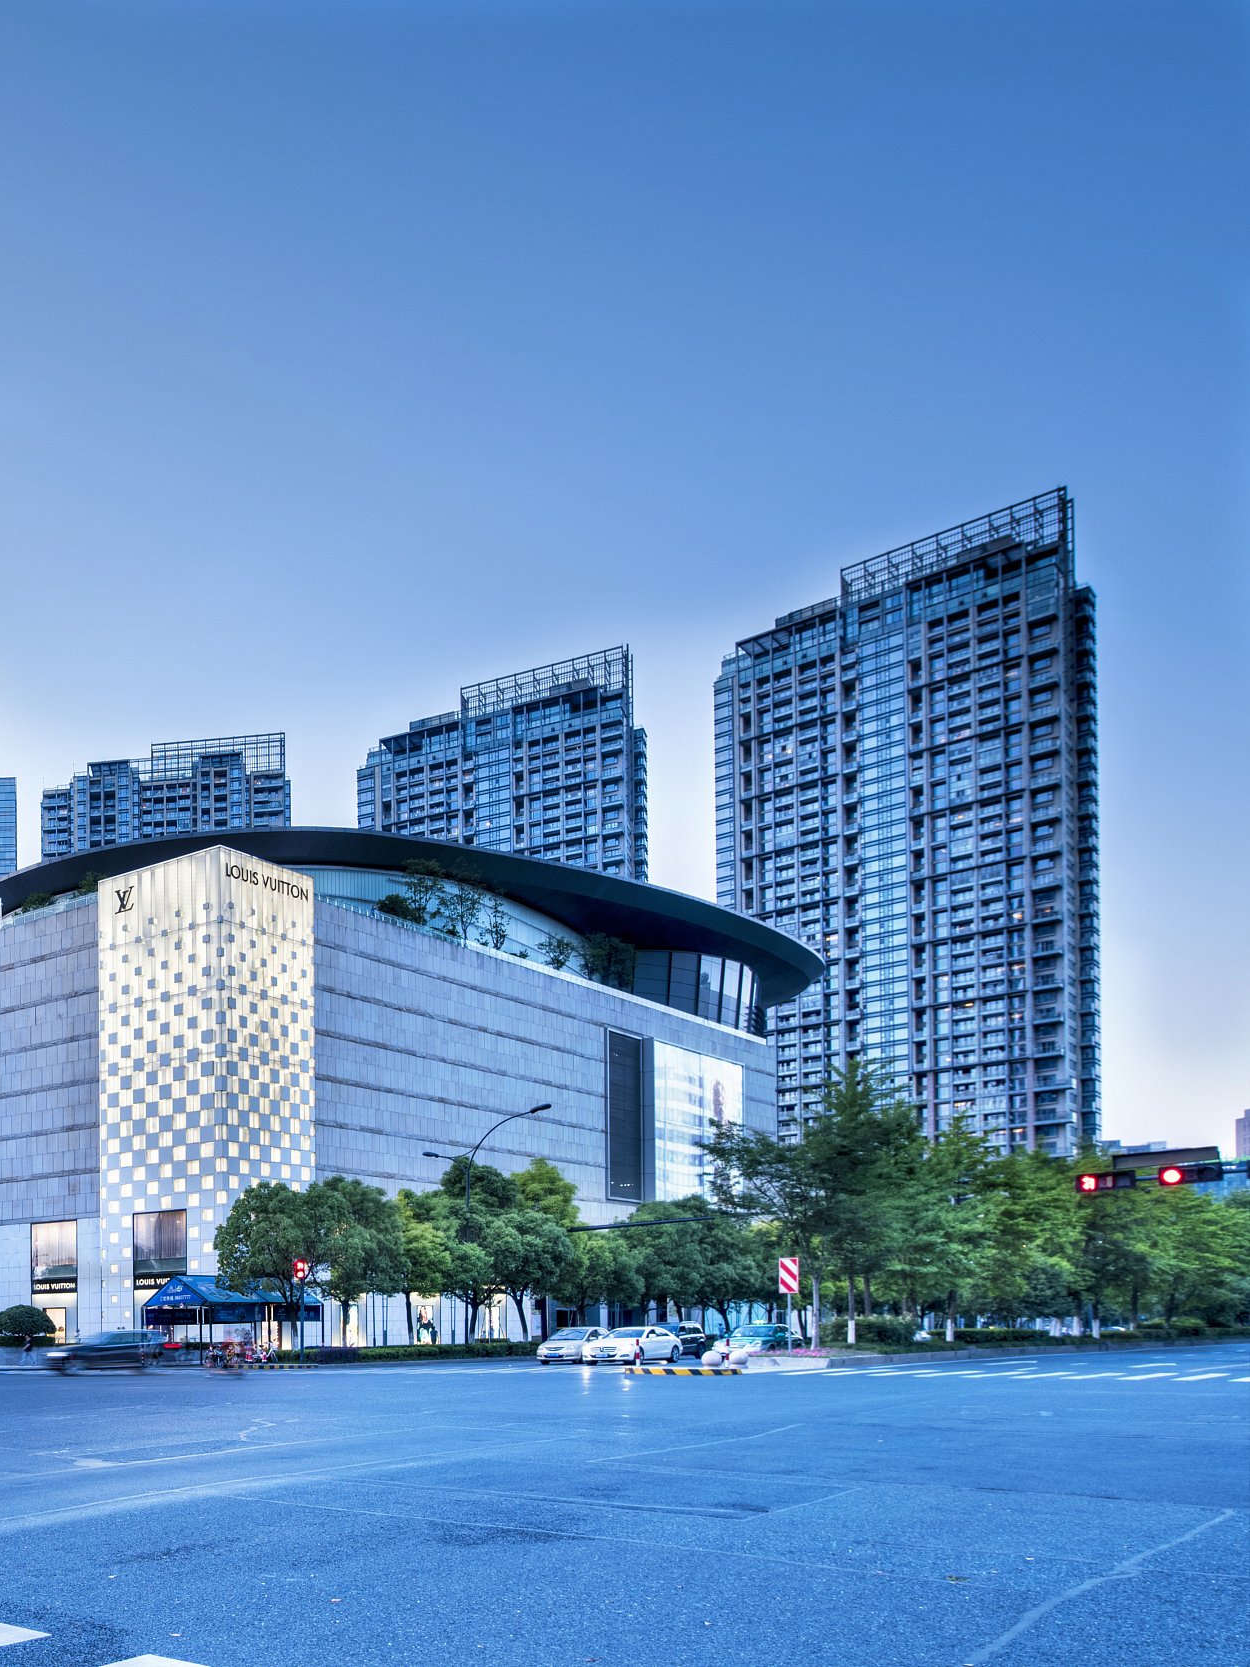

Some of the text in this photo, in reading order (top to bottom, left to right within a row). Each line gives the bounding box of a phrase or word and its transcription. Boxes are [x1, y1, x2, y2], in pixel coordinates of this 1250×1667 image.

[225, 862, 309, 902] LOUIS VUITTON
[33, 1282, 76, 1291] LOUIS VUITTON
[136, 1278, 155, 1286] LOUIS
